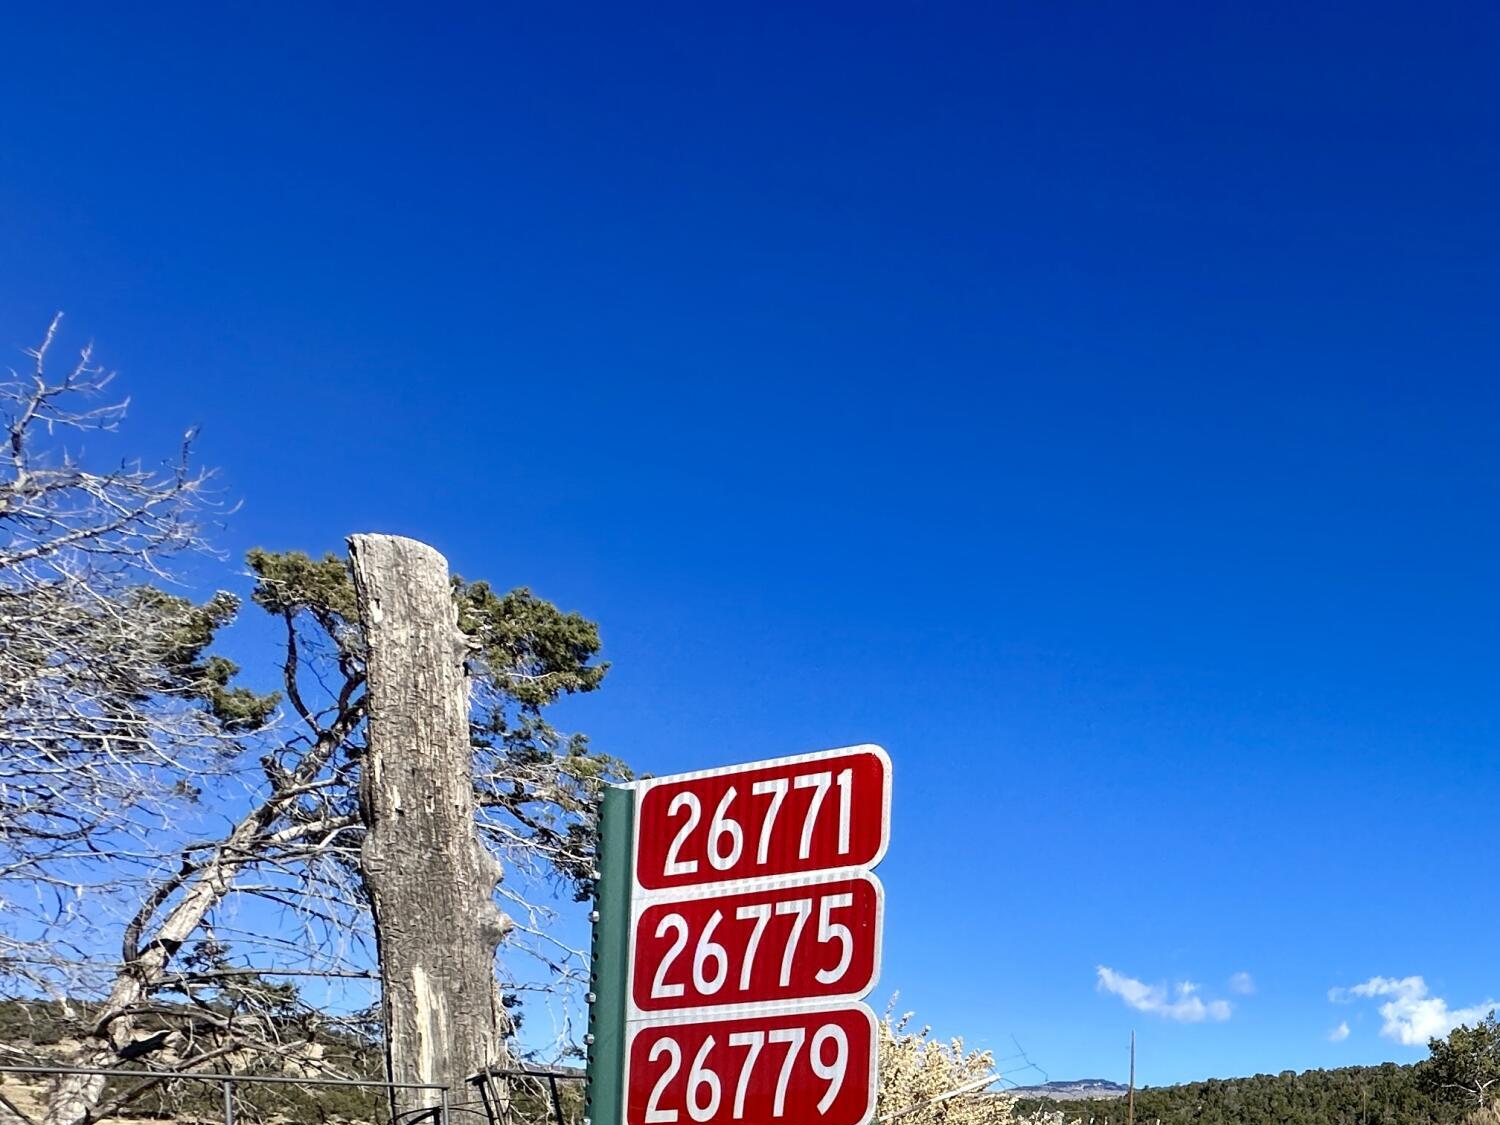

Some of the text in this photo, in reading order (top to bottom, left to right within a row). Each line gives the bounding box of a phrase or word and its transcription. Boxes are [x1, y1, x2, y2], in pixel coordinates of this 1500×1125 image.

[663, 768, 853, 876] 26771
[650, 893, 853, 999] 26775
[644, 1023, 849, 1124] 26779
